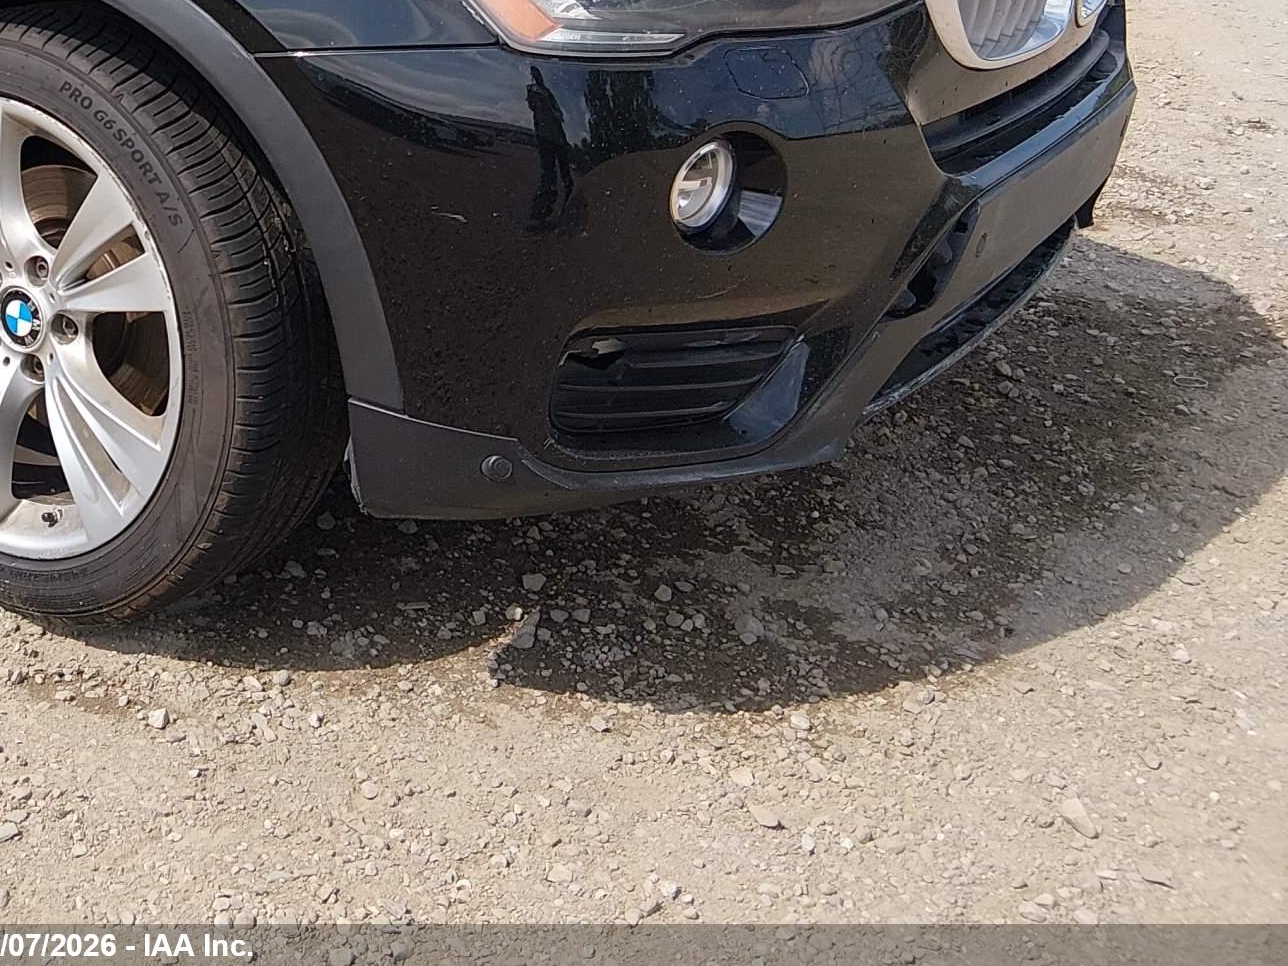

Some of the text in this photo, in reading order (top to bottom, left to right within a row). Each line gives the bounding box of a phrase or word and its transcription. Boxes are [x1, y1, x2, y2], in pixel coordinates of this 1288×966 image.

[59, 80, 93, 110] PRO
[112, 128, 162, 185] SPORT
[155, 190, 183, 227] A/S
